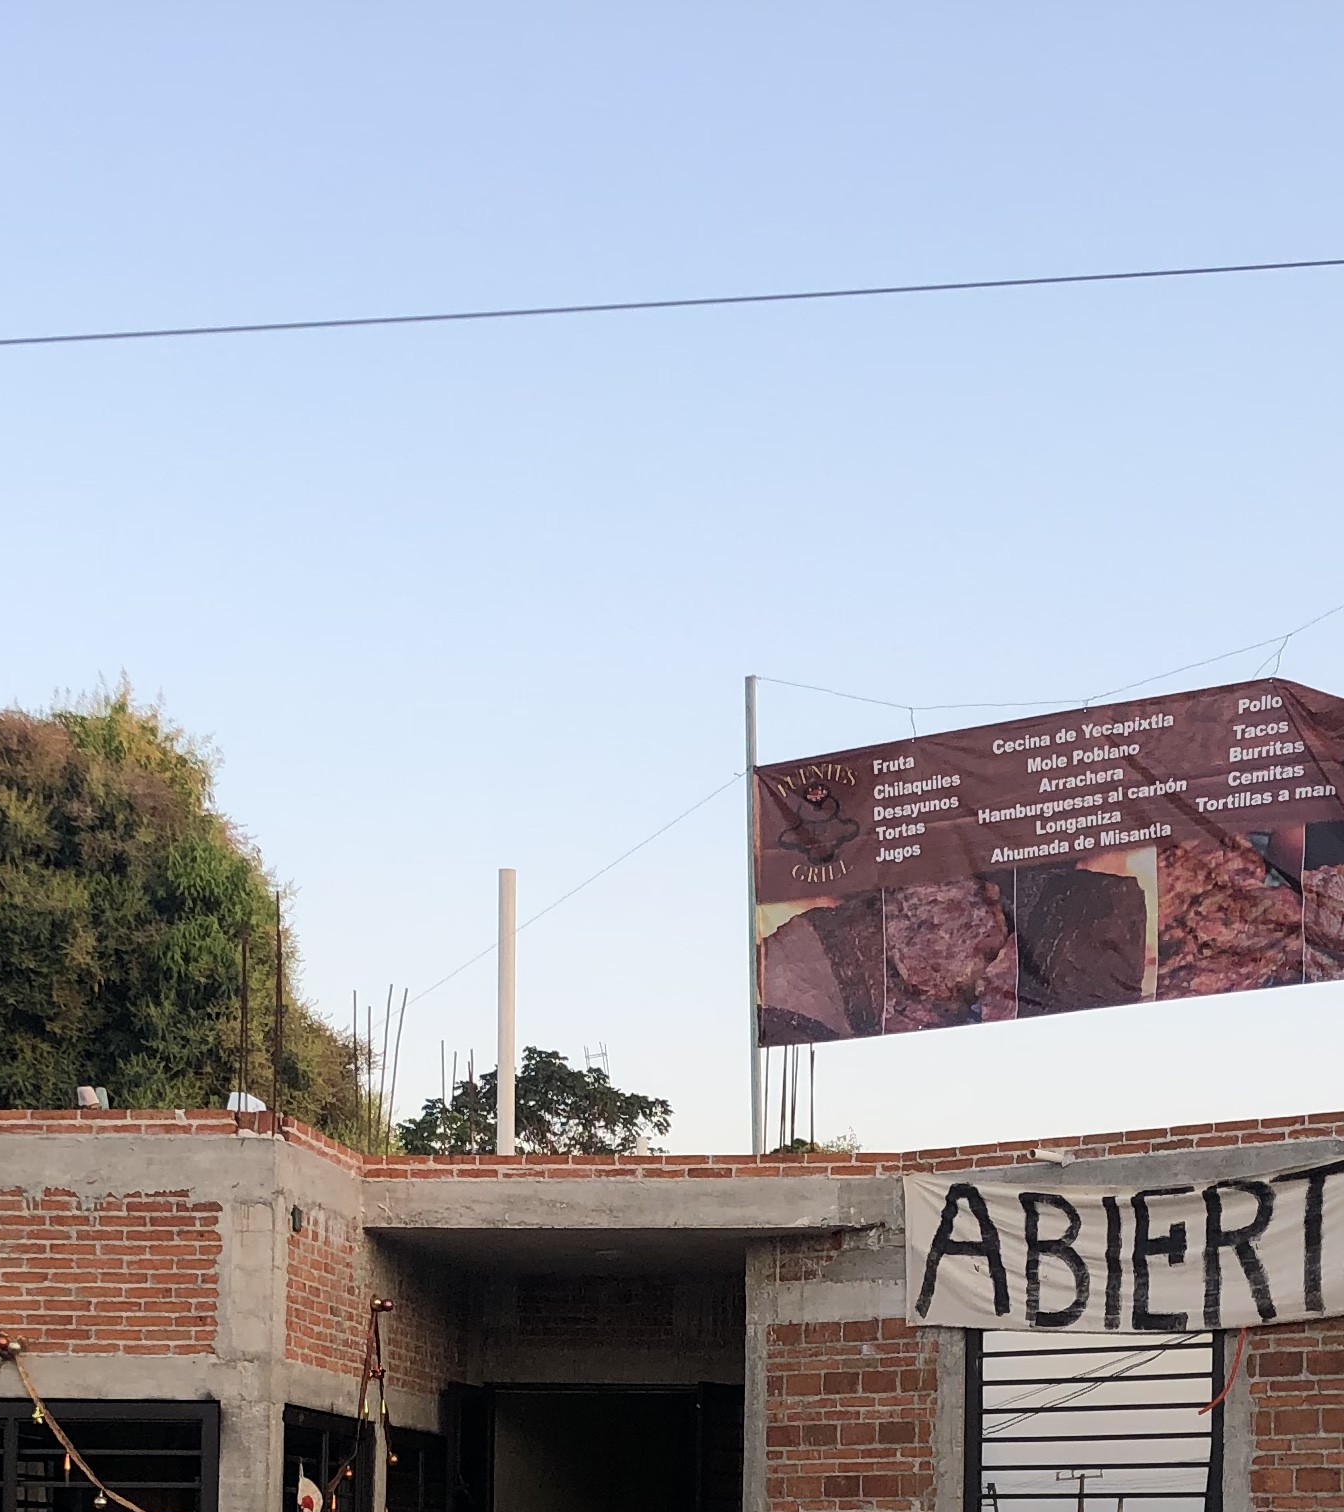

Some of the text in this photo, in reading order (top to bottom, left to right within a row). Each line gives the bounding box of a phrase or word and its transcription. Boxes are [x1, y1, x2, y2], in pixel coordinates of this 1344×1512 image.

[1238, 695, 1283, 714] Pollo
[992, 713, 1174, 754] Cecina de Yecapixtla
[1233, 721, 1289, 740] Tacos
[1027, 743, 1140, 773] Mole Poblano
[1229, 740, 1305, 763] Burritas
[873, 756, 915, 774] Fruta
[1227, 765, 1305, 787] Cemitas
[873, 774, 961, 800] Chilaquiles
[1039, 768, 1124, 793] Arrachera
[873, 796, 959, 821] Desayunos
[978, 777, 1187, 824] Hamburguesas al carbón
[1195, 784, 1336, 813] Tortillas a man
[875, 822, 926, 840] Tortas
[1036, 810, 1122, 835] Longaniza
[875, 844, 921, 862] Jugos
[990, 822, 1172, 864] Ahumada de Misantla
[791, 860, 854, 882] GRILL
